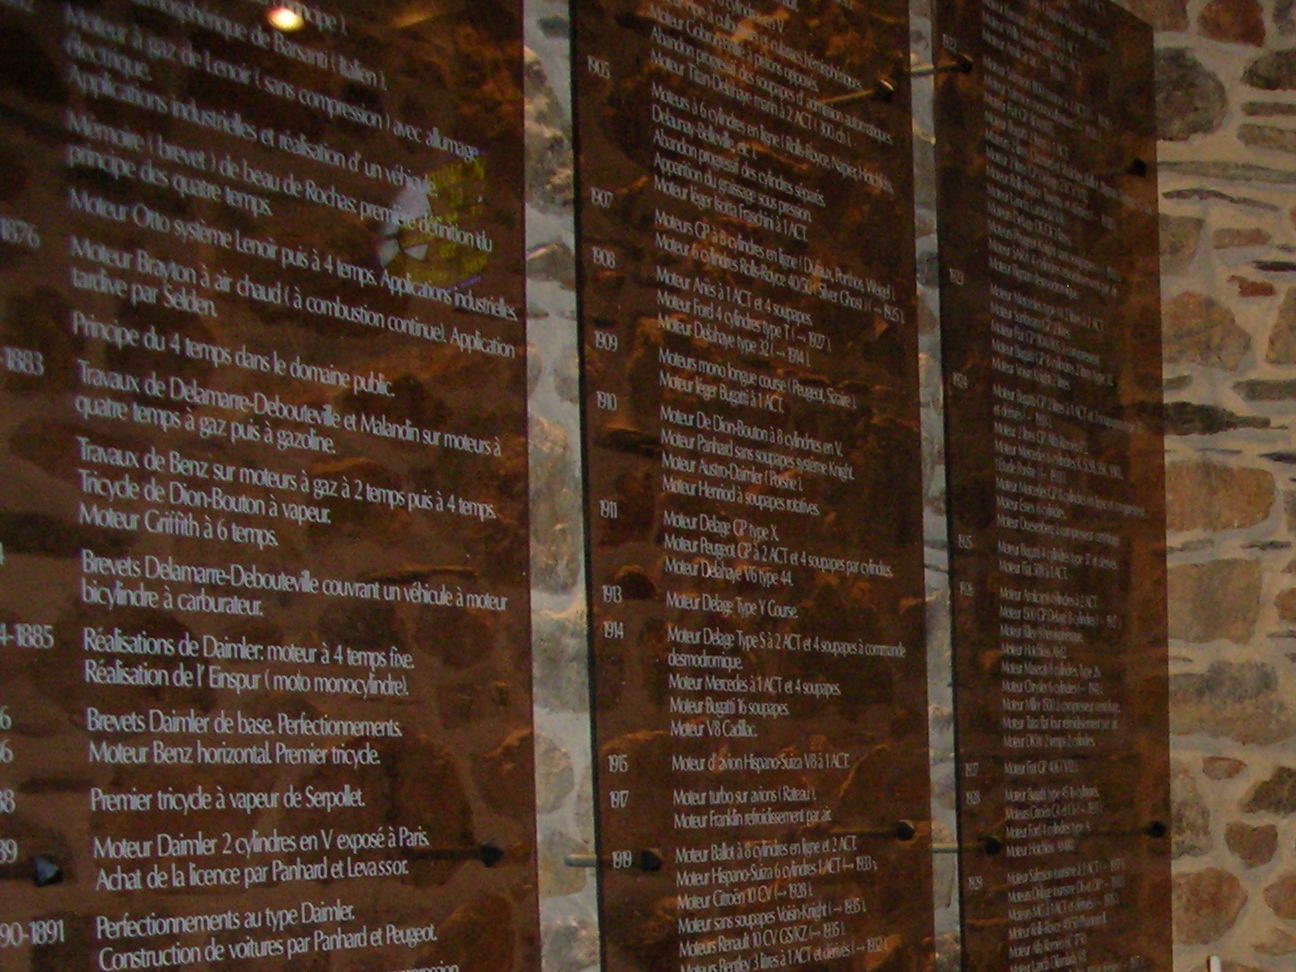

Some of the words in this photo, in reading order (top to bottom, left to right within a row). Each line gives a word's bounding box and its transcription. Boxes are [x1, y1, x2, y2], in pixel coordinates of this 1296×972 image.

[78, 361, 139, 390] Travaux
[143, 374, 166, 395] de
[169, 379, 340, 424] Delamarre-Debouteville
[343, 413, 357, 429] et
[360, 415, 420, 439] Malandin
[422, 429, 442, 443] sur
[443, 433, 492, 452] moteurs
[492, 436, 502, 455] à
[79, 470, 140, 498] Tricycle
[143, 480, 166, 500] de
[169, 483, 266, 512] Dion-Bouton
[268, 495, 278, 515] à
[282, 504, 331, 524] vapeur.
[77, 504, 139, 528] Moteur
[144, 510, 200, 535] Griffith
[202, 517, 213, 537] à
[216, 519, 228, 539] 6
[231, 524, 279, 546] temps.
[80, 551, 141, 576] Brevets
[145, 558, 319, 591] Delamarre-Debouteville
[322, 580, 380, 597] couvrant
[382, 585, 401, 599] un
[403, 583, 453, 603] véhicule
[455, 587, 464, 605] à
[466, 593, 508, 608] moteur
[602, 585, 623, 602] 1913
[79, 581, 159, 607] bicylindre
[162, 587, 174, 608] à
[177, 593, 263, 614] carburateur.
[603, 620, 624, 639] 1914
[82, 629, 175, 653] Réalisations
[177, 635, 200, 655] de
[202, 636, 264, 658] Daimler:
[266, 644, 317, 661] moteur
[320, 643, 330, 663] à
[333, 644, 344, 663] 4
[346, 648, 387, 667] temps
[389, 647, 415, 667] fixe.
[85, 708, 145, 730] Brevets
[148, 710, 210, 731] Daimler
[213, 712, 234, 732] de
[237, 713, 274, 732] base.
[277, 714, 401, 734] Perfectionnements.
[88, 742, 149, 761] Moteur
[152, 741, 193, 762] Benz
[196, 742, 271, 762] horizontal.
[275, 743, 328, 762] Premier
[331, 744, 381, 765] tricycle.
[88, 789, 153, 809] Premier
[156, 788, 212, 811] tricycle
[215, 787, 226, 808] à
[229, 792, 280, 809] vapeur
[282, 787, 303, 806] de
[305, 786, 365, 808] Serpollet.
[95, 912, 240, 935] Perfectionnements
[243, 911, 262, 926] au
[265, 908, 298, 927] type
[301, 901, 354, 921] Daimler.
[97, 946, 202, 968] Construction
[204, 939, 225, 959] de
[228, 937, 284, 956] voitures
[286, 937, 311, 955] par
[313, 927, 368, 949] Panhard
[369, 928, 383, 944] et
[385, 924, 438, 944] Peugeot.
